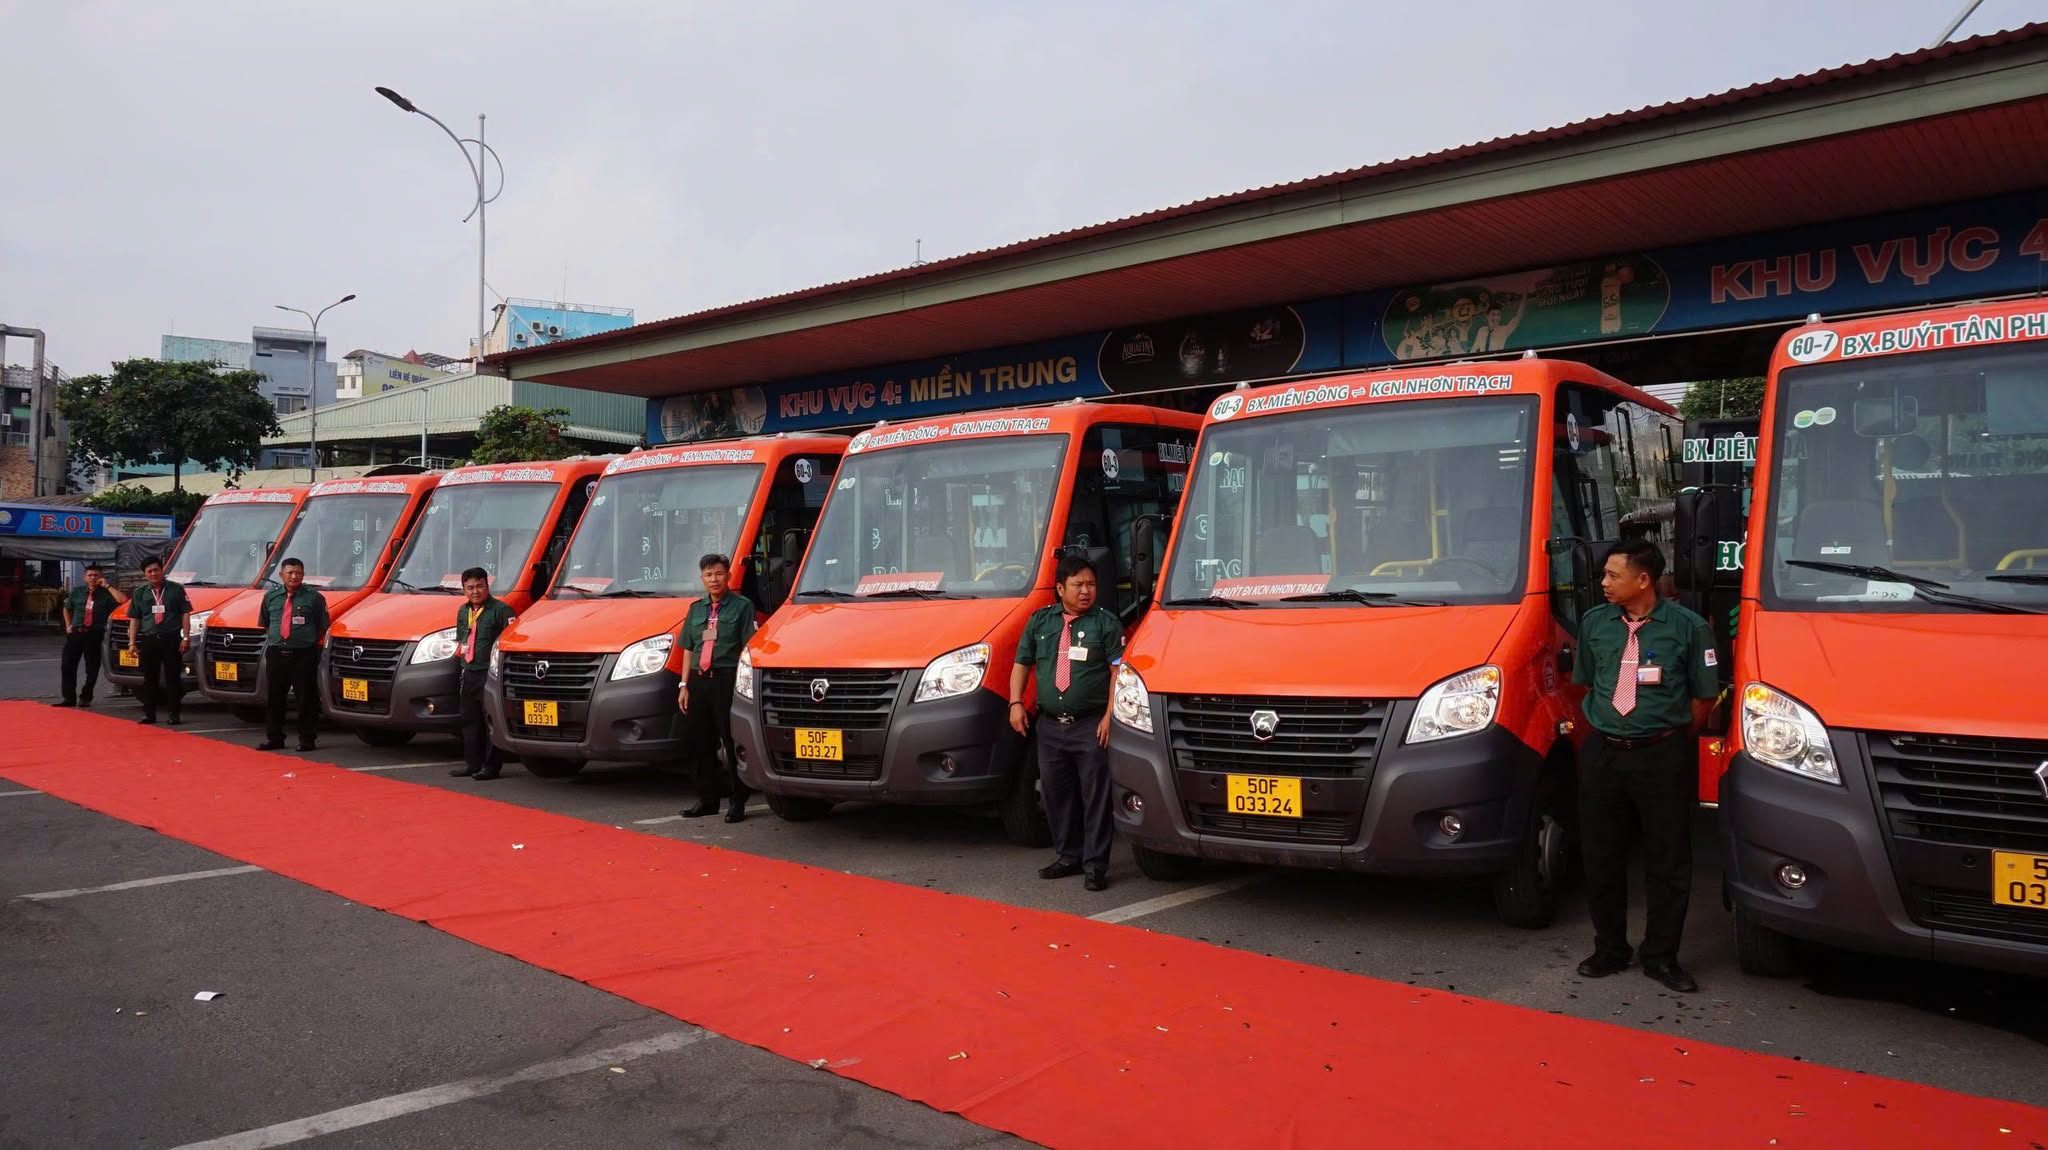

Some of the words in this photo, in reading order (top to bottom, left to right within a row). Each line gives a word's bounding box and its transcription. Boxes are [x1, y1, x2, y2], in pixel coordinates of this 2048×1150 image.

[1711, 249, 1836, 304] KHU
[1853, 226, 2000, 286] VỰC
[1792, 332, 1836, 357] 60-7
[1842, 320, 1948, 358] BX.BUÝT
[1949, 315, 2002, 345] TÂN
[779, 390, 824, 418] KHU
[828, 381, 876, 415] VỰC
[910, 364, 972, 402] MIỀN
[979, 356, 1077, 393] TRUNG
[1213, 396, 1243, 417] 60-3
[1245, 389, 1304, 413] BX.MIỀN
[1304, 384, 1350, 405] ĐÔNG
[1369, 376, 1458, 398] KCN.NHƠN
[1457, 375, 1512, 396] TRẠCH
[908, 424, 939, 441] ĐÔNG
[1009, 417, 1050, 434] TRẠCH
[796, 463, 812, 480] 60-3
[39, 513, 95, 533] E.01
[1252, 585, 1268, 595] KCN
[533, 702, 547, 713] 50F
[528, 713, 553, 725] 033.31
[807, 731, 828, 744] 50F
[800, 744, 837, 759] 033.27
[1247, 777, 1279, 795] 50F
[1235, 795, 1293, 815] 033.24
